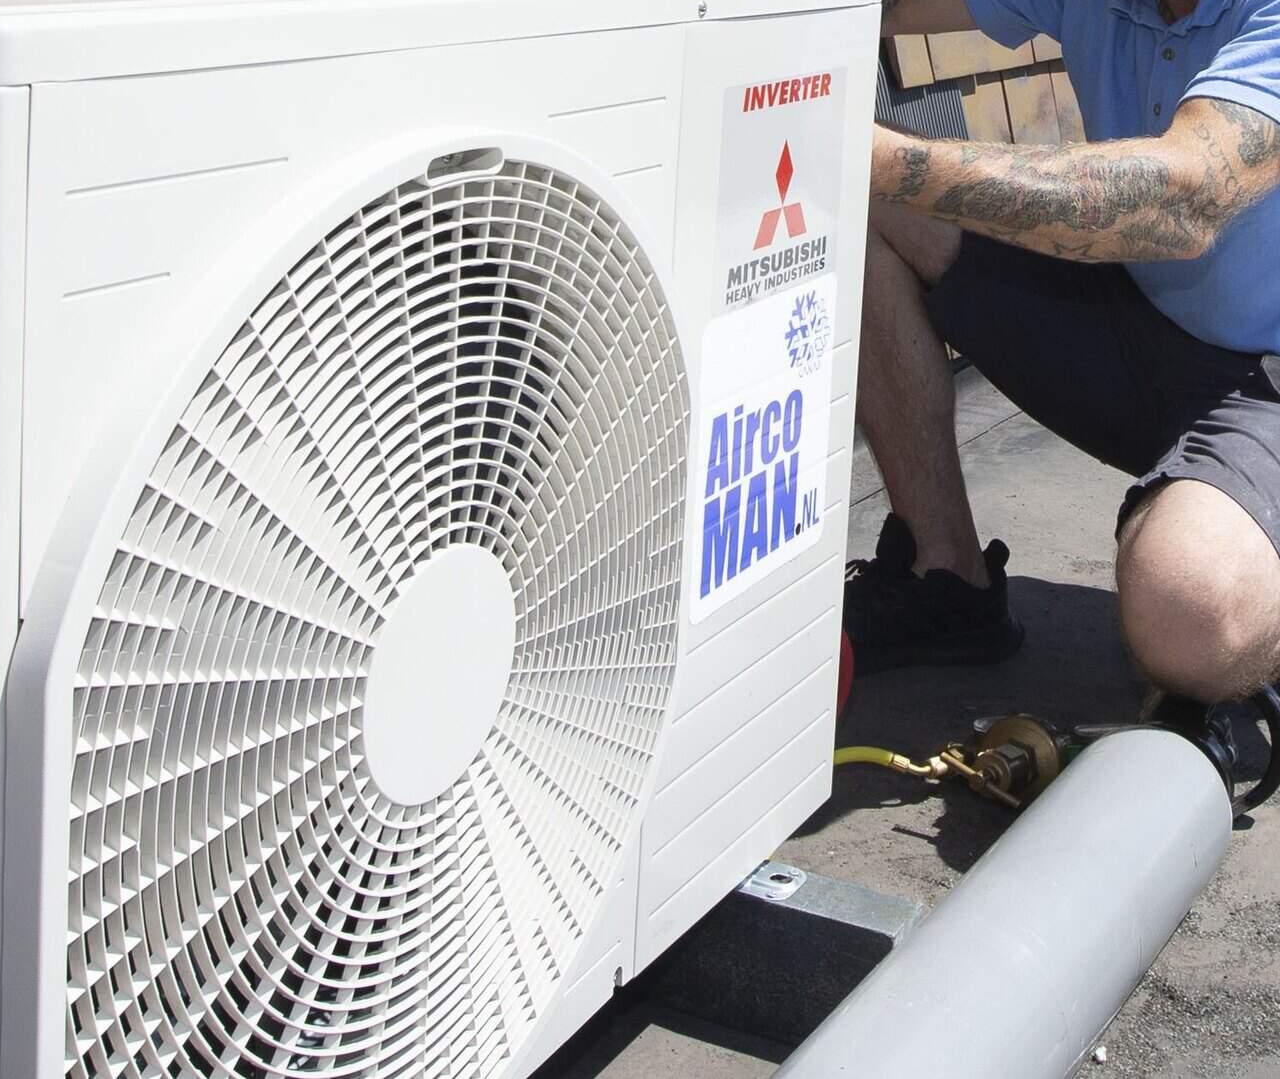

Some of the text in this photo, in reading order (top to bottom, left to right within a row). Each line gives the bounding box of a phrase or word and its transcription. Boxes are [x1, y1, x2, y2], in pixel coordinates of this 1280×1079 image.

[743, 73, 831, 112] INVERTER
[726, 257, 825, 305] HEAVY INDUSTRIES
[727, 236, 826, 289] MITSUBISHI
